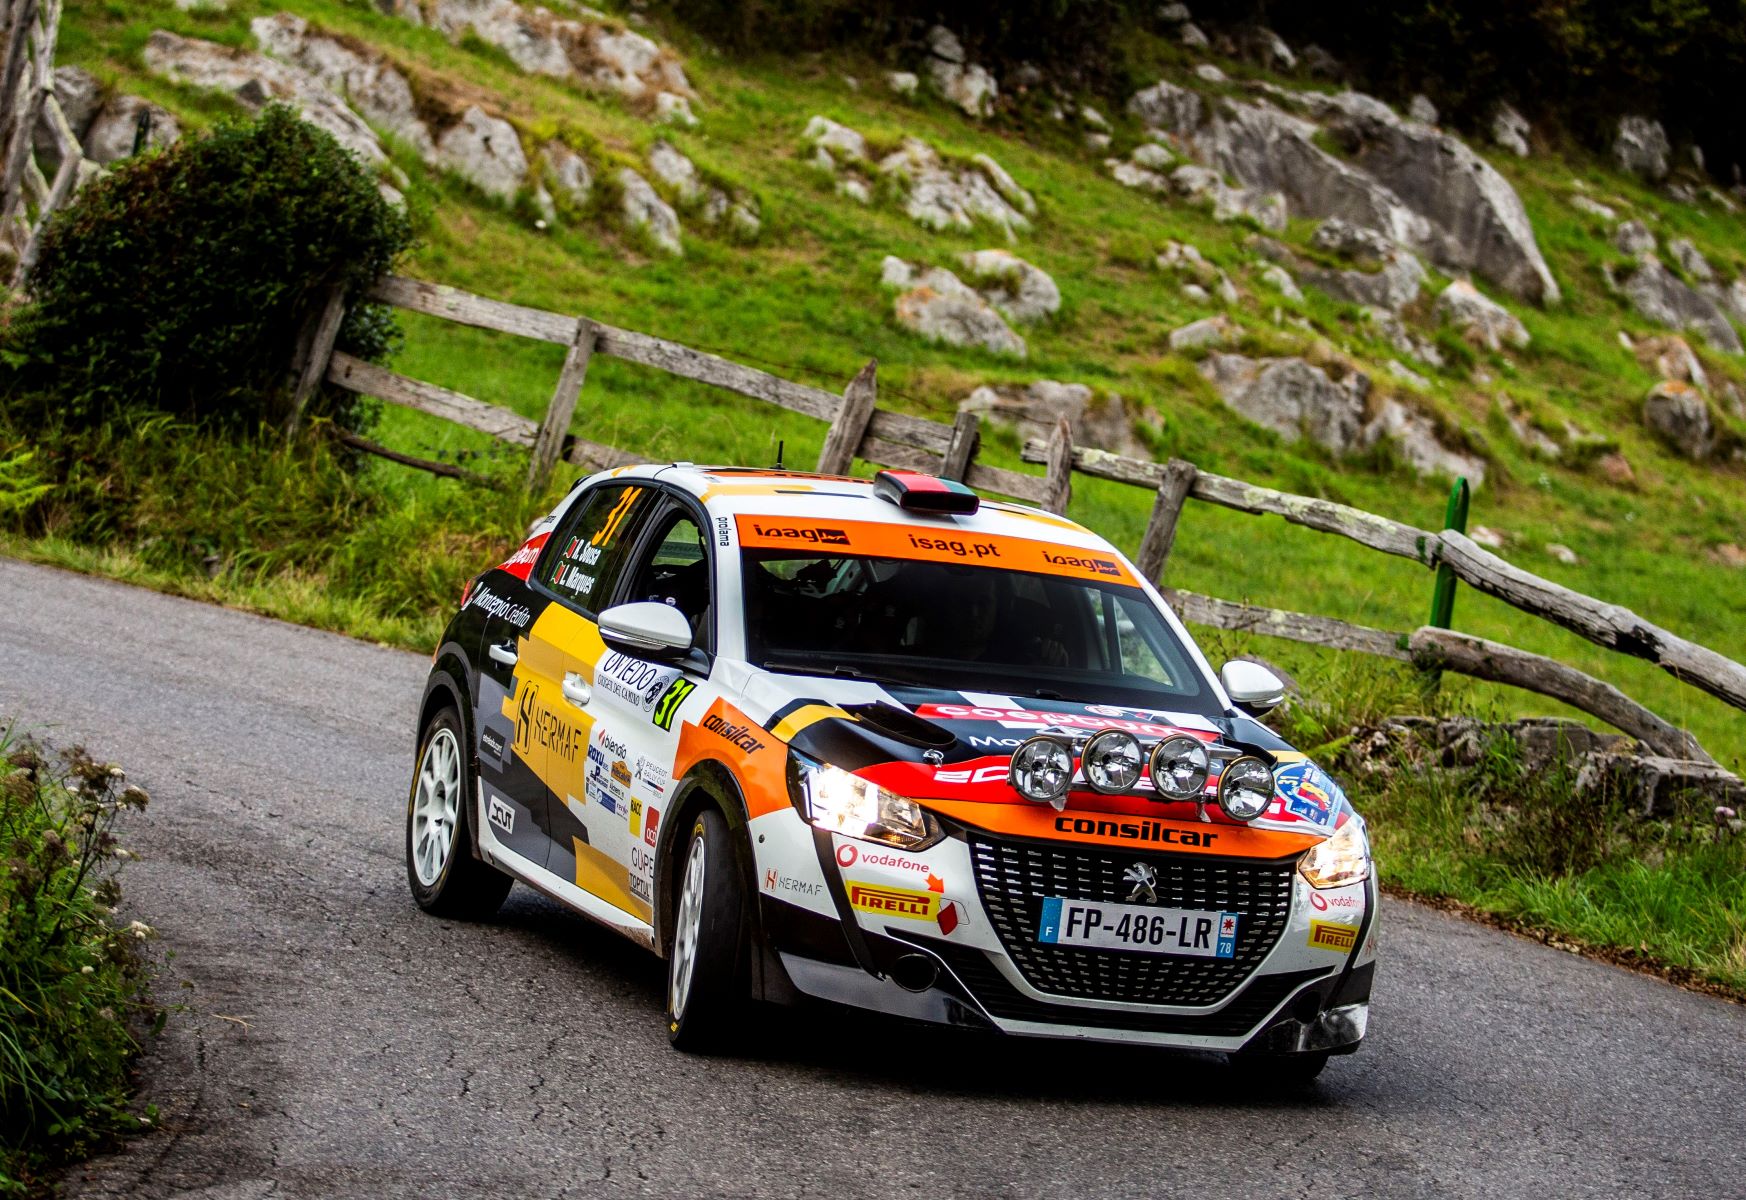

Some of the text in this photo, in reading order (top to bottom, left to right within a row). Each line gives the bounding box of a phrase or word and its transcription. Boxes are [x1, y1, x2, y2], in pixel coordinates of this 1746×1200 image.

[591, 486, 643, 547] 31
[579, 541, 602, 566] Sousa
[908, 534, 1001, 558] isag.pt
[565, 566, 595, 596] Marques
[472, 587, 531, 628] Montepio Crédito
[603, 652, 658, 691] OVIEDO
[654, 679, 695, 730] 31
[534, 706, 582, 763] HERMAF
[702, 713, 766, 755] consilcar
[1054, 816, 1219, 848] consilcar
[861, 852, 930, 873] vodafone
[778, 876, 823, 896] HERMAF
[851, 885, 931, 916] PIRELLI
[1045, 906, 1232, 954] F FP-486-LR 78
[1313, 924, 1356, 948] PIRELLI
